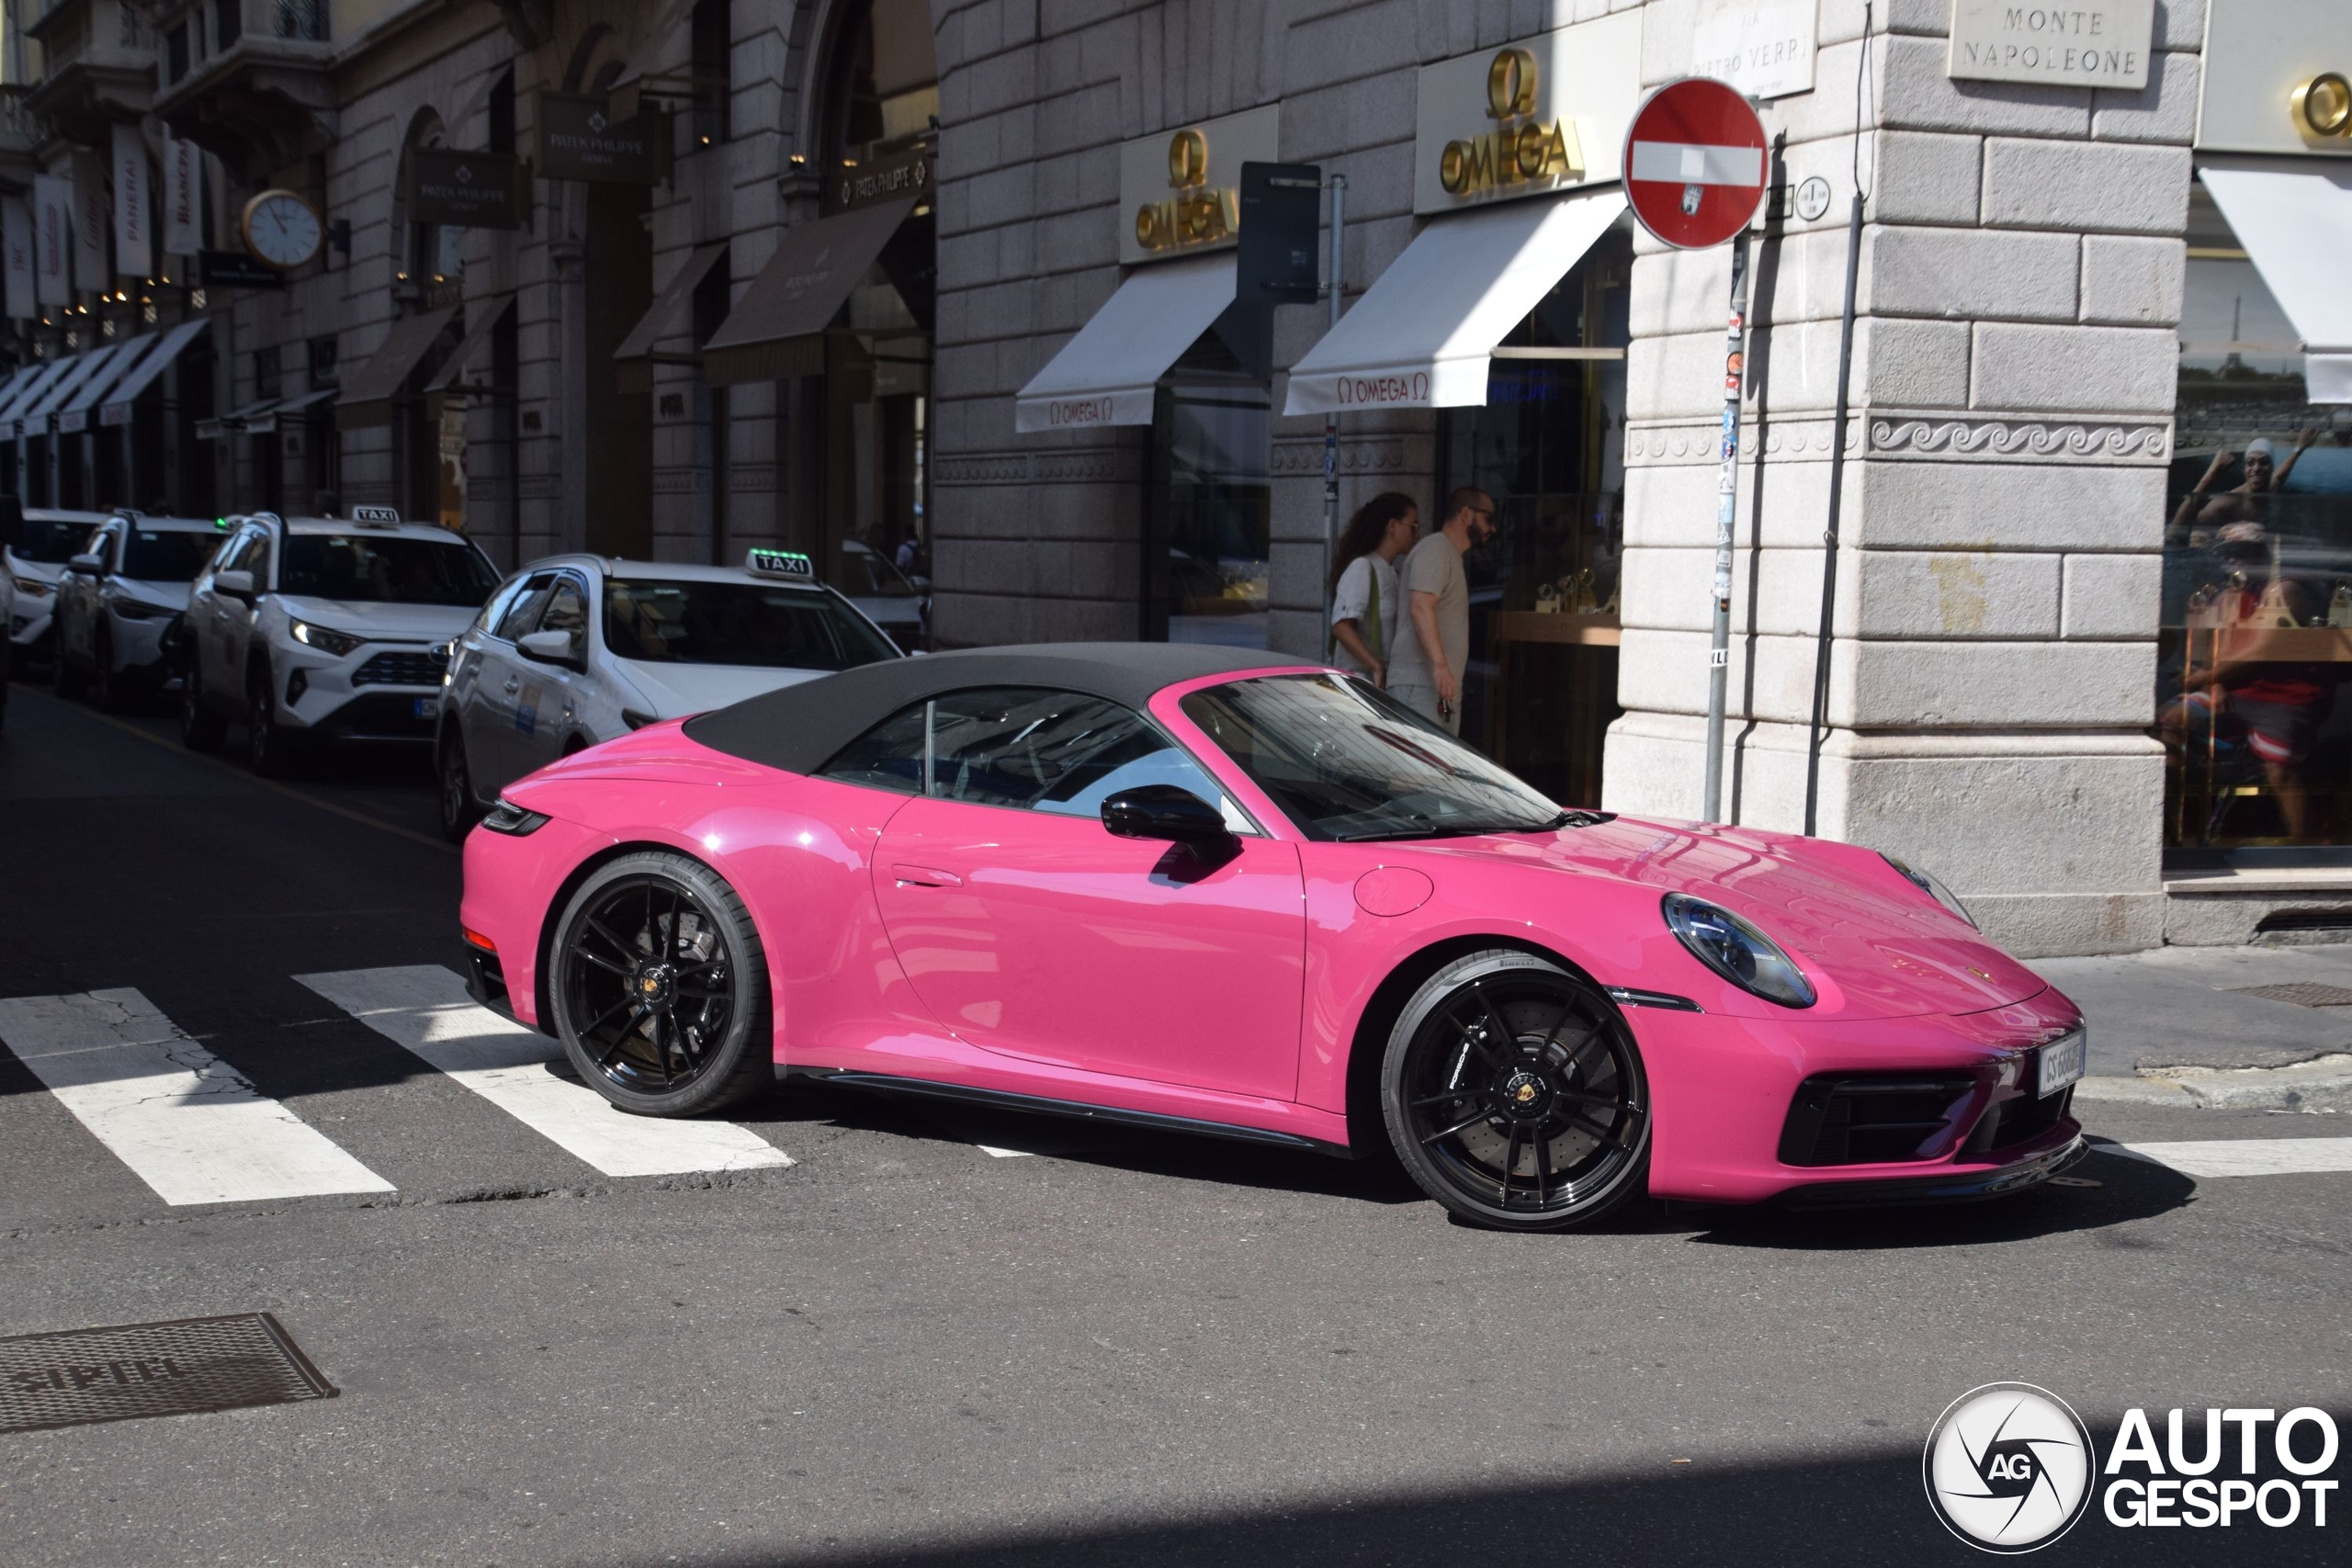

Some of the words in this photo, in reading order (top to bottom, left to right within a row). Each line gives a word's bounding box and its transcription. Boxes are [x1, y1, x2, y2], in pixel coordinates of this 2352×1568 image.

[2003, 7, 2104, 36] MONTE
[1749, 35, 1807, 69] VERRI
[1962, 42, 2137, 75] NAPOLEONE
[551, 133, 588, 150] PATEK
[591, 137, 645, 155] PHILIPPE
[1441, 115, 1586, 194] OMEGA
[421, 184, 458, 199] PATEK
[458, 187, 505, 203] PHILIPPE
[855, 176, 878, 199] PATEK
[878, 165, 910, 193] PHILIPPE
[125, 159, 139, 242] PANERAI
[1136, 188, 1239, 250] OMEGA
[1356, 378, 1408, 403] OMEGA
[1063, 402, 1100, 423] OMEGA
[359, 510, 394, 521] TAXI
[758, 556, 805, 572] TAXI
[1499, 958, 1535, 967] PIRELLI
[1449, 1042, 1470, 1090] PORSCHE
